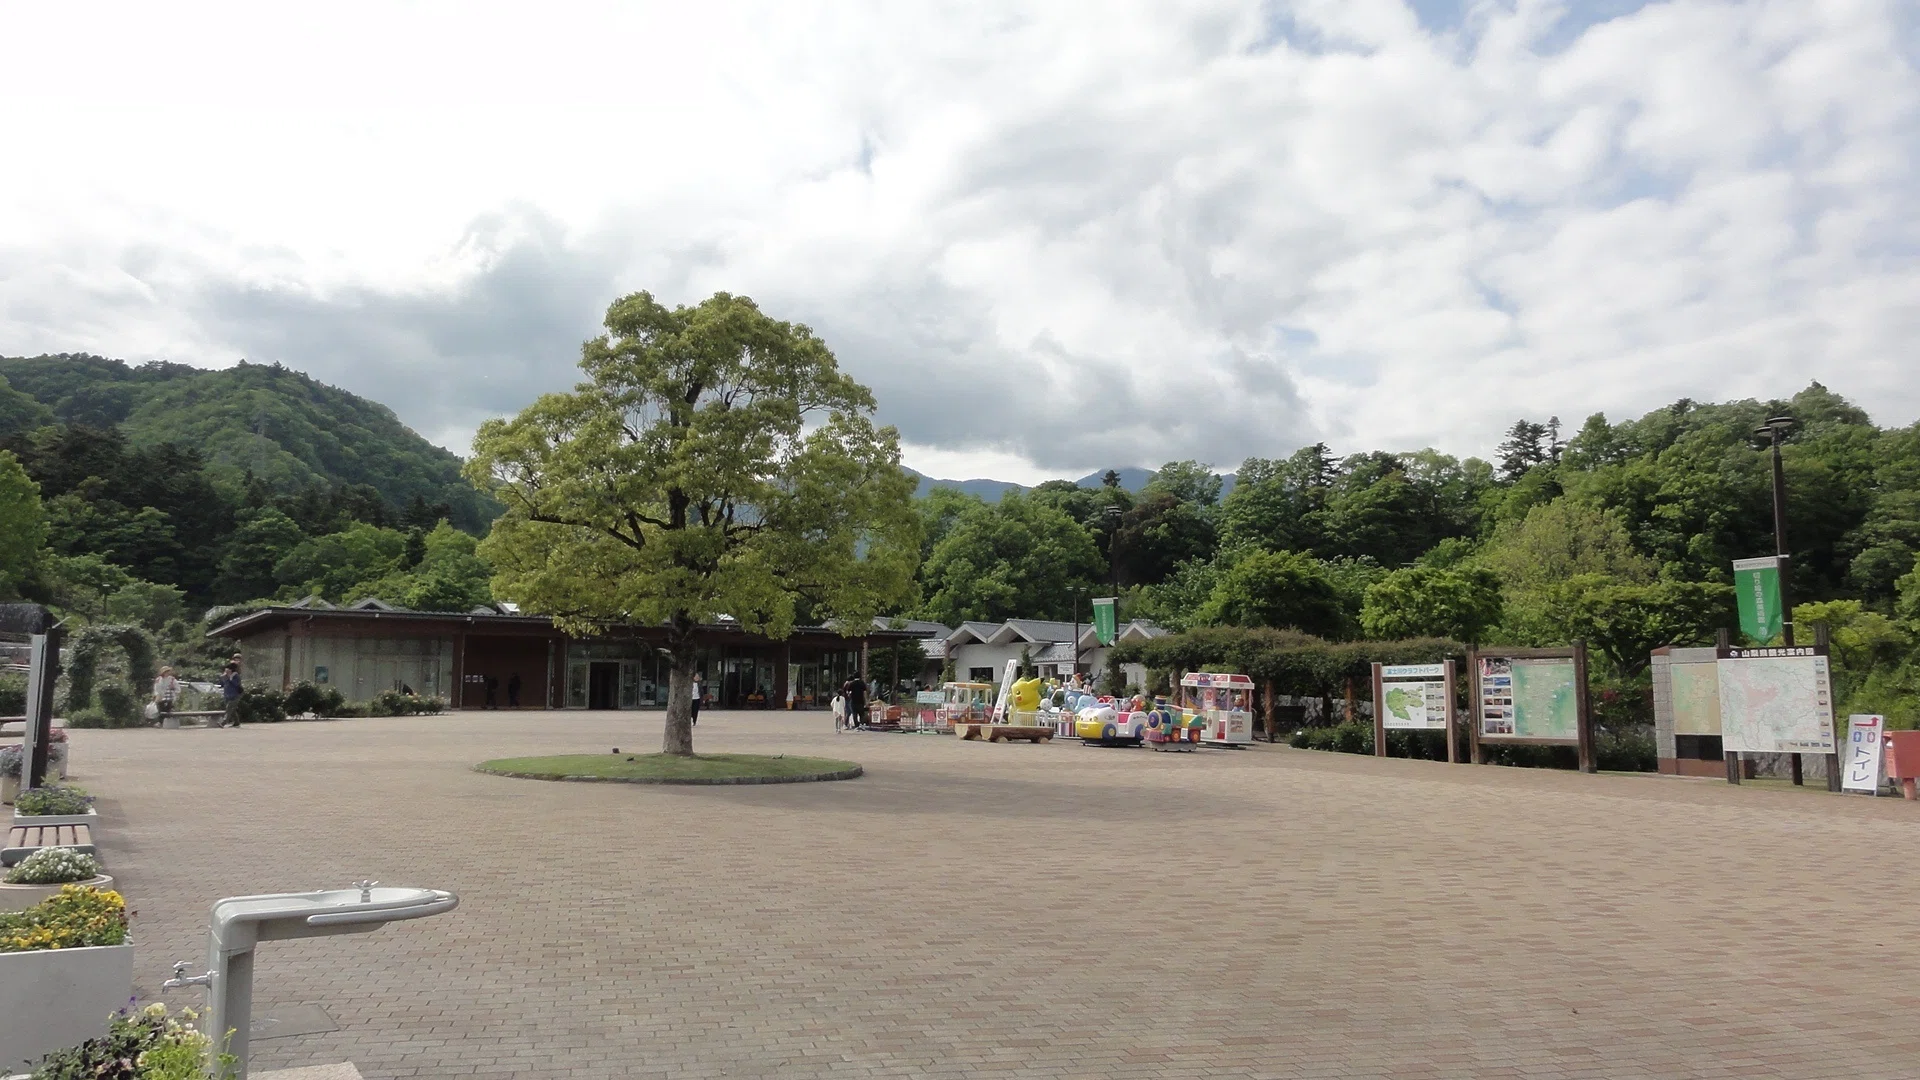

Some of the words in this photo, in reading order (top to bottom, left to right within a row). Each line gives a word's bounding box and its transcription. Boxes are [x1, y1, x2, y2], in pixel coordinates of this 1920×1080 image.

[1386, 667, 1440, 675] 富士川クラフトパーク
[1853, 746, 1871, 782] トイレ
